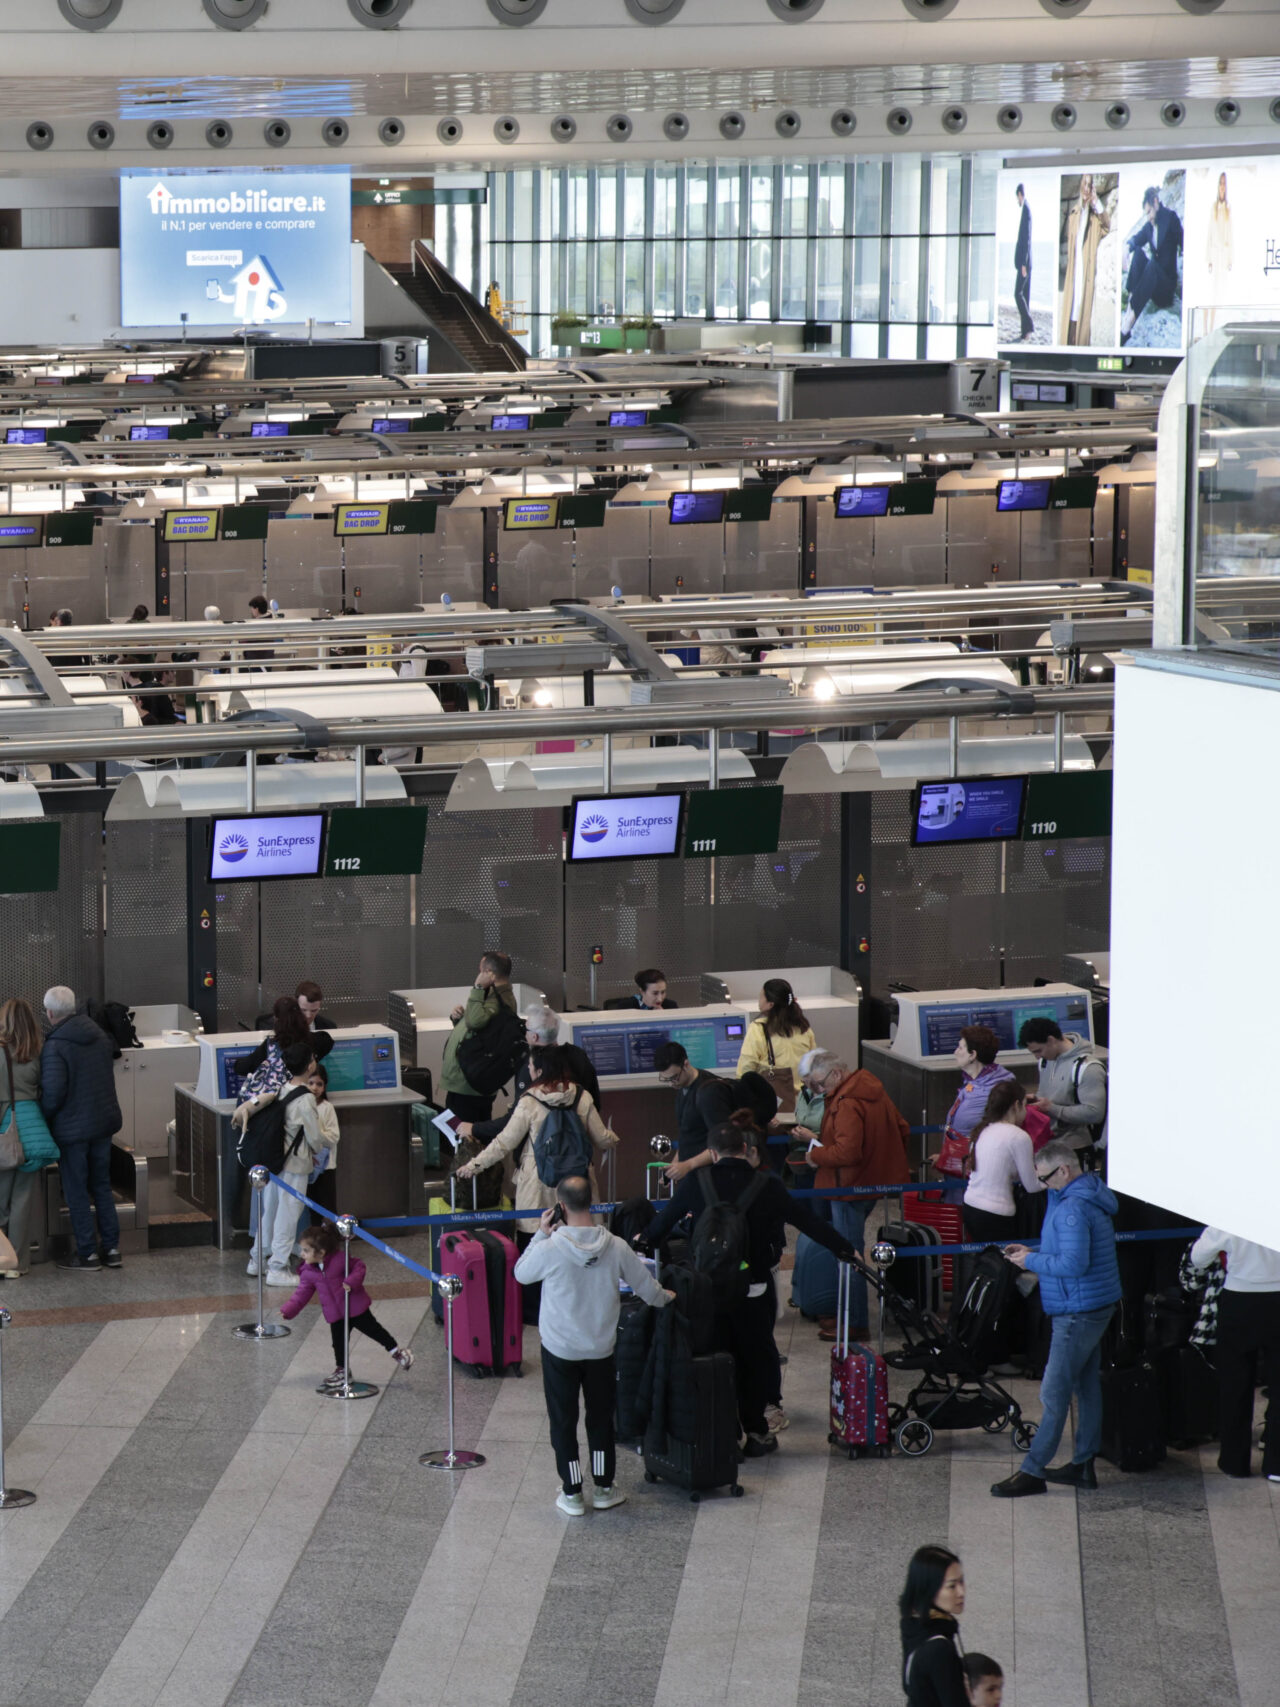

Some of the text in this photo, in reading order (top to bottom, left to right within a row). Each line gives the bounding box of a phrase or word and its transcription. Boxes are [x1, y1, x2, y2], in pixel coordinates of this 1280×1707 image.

[170, 220, 186, 231] N.1
[188, 222, 206, 232] per
[209, 220, 252, 230] vendere
[255, 221, 262, 230] e
[265, 220, 315, 231] comprare
[191, 254, 219, 262] Scarica
[394, 345, 406, 362] 5
[970, 369, 986, 392] 7
[0, 527, 35, 536] RYANAIR
[173, 526, 187, 534] BAG
[813, 623, 868, 634] SONO 100%
[617, 815, 673, 828] SunExpress
[1031, 821, 1057, 834] 1110
[616, 827, 650, 838] Airlines
[257, 835, 315, 848] SunExpress
[692, 838, 717, 852] 1111
[256, 846, 292, 857] Airlines
[333, 857, 361, 870] 1112
[451, 1212, 503, 1222] Milano Malpensa
